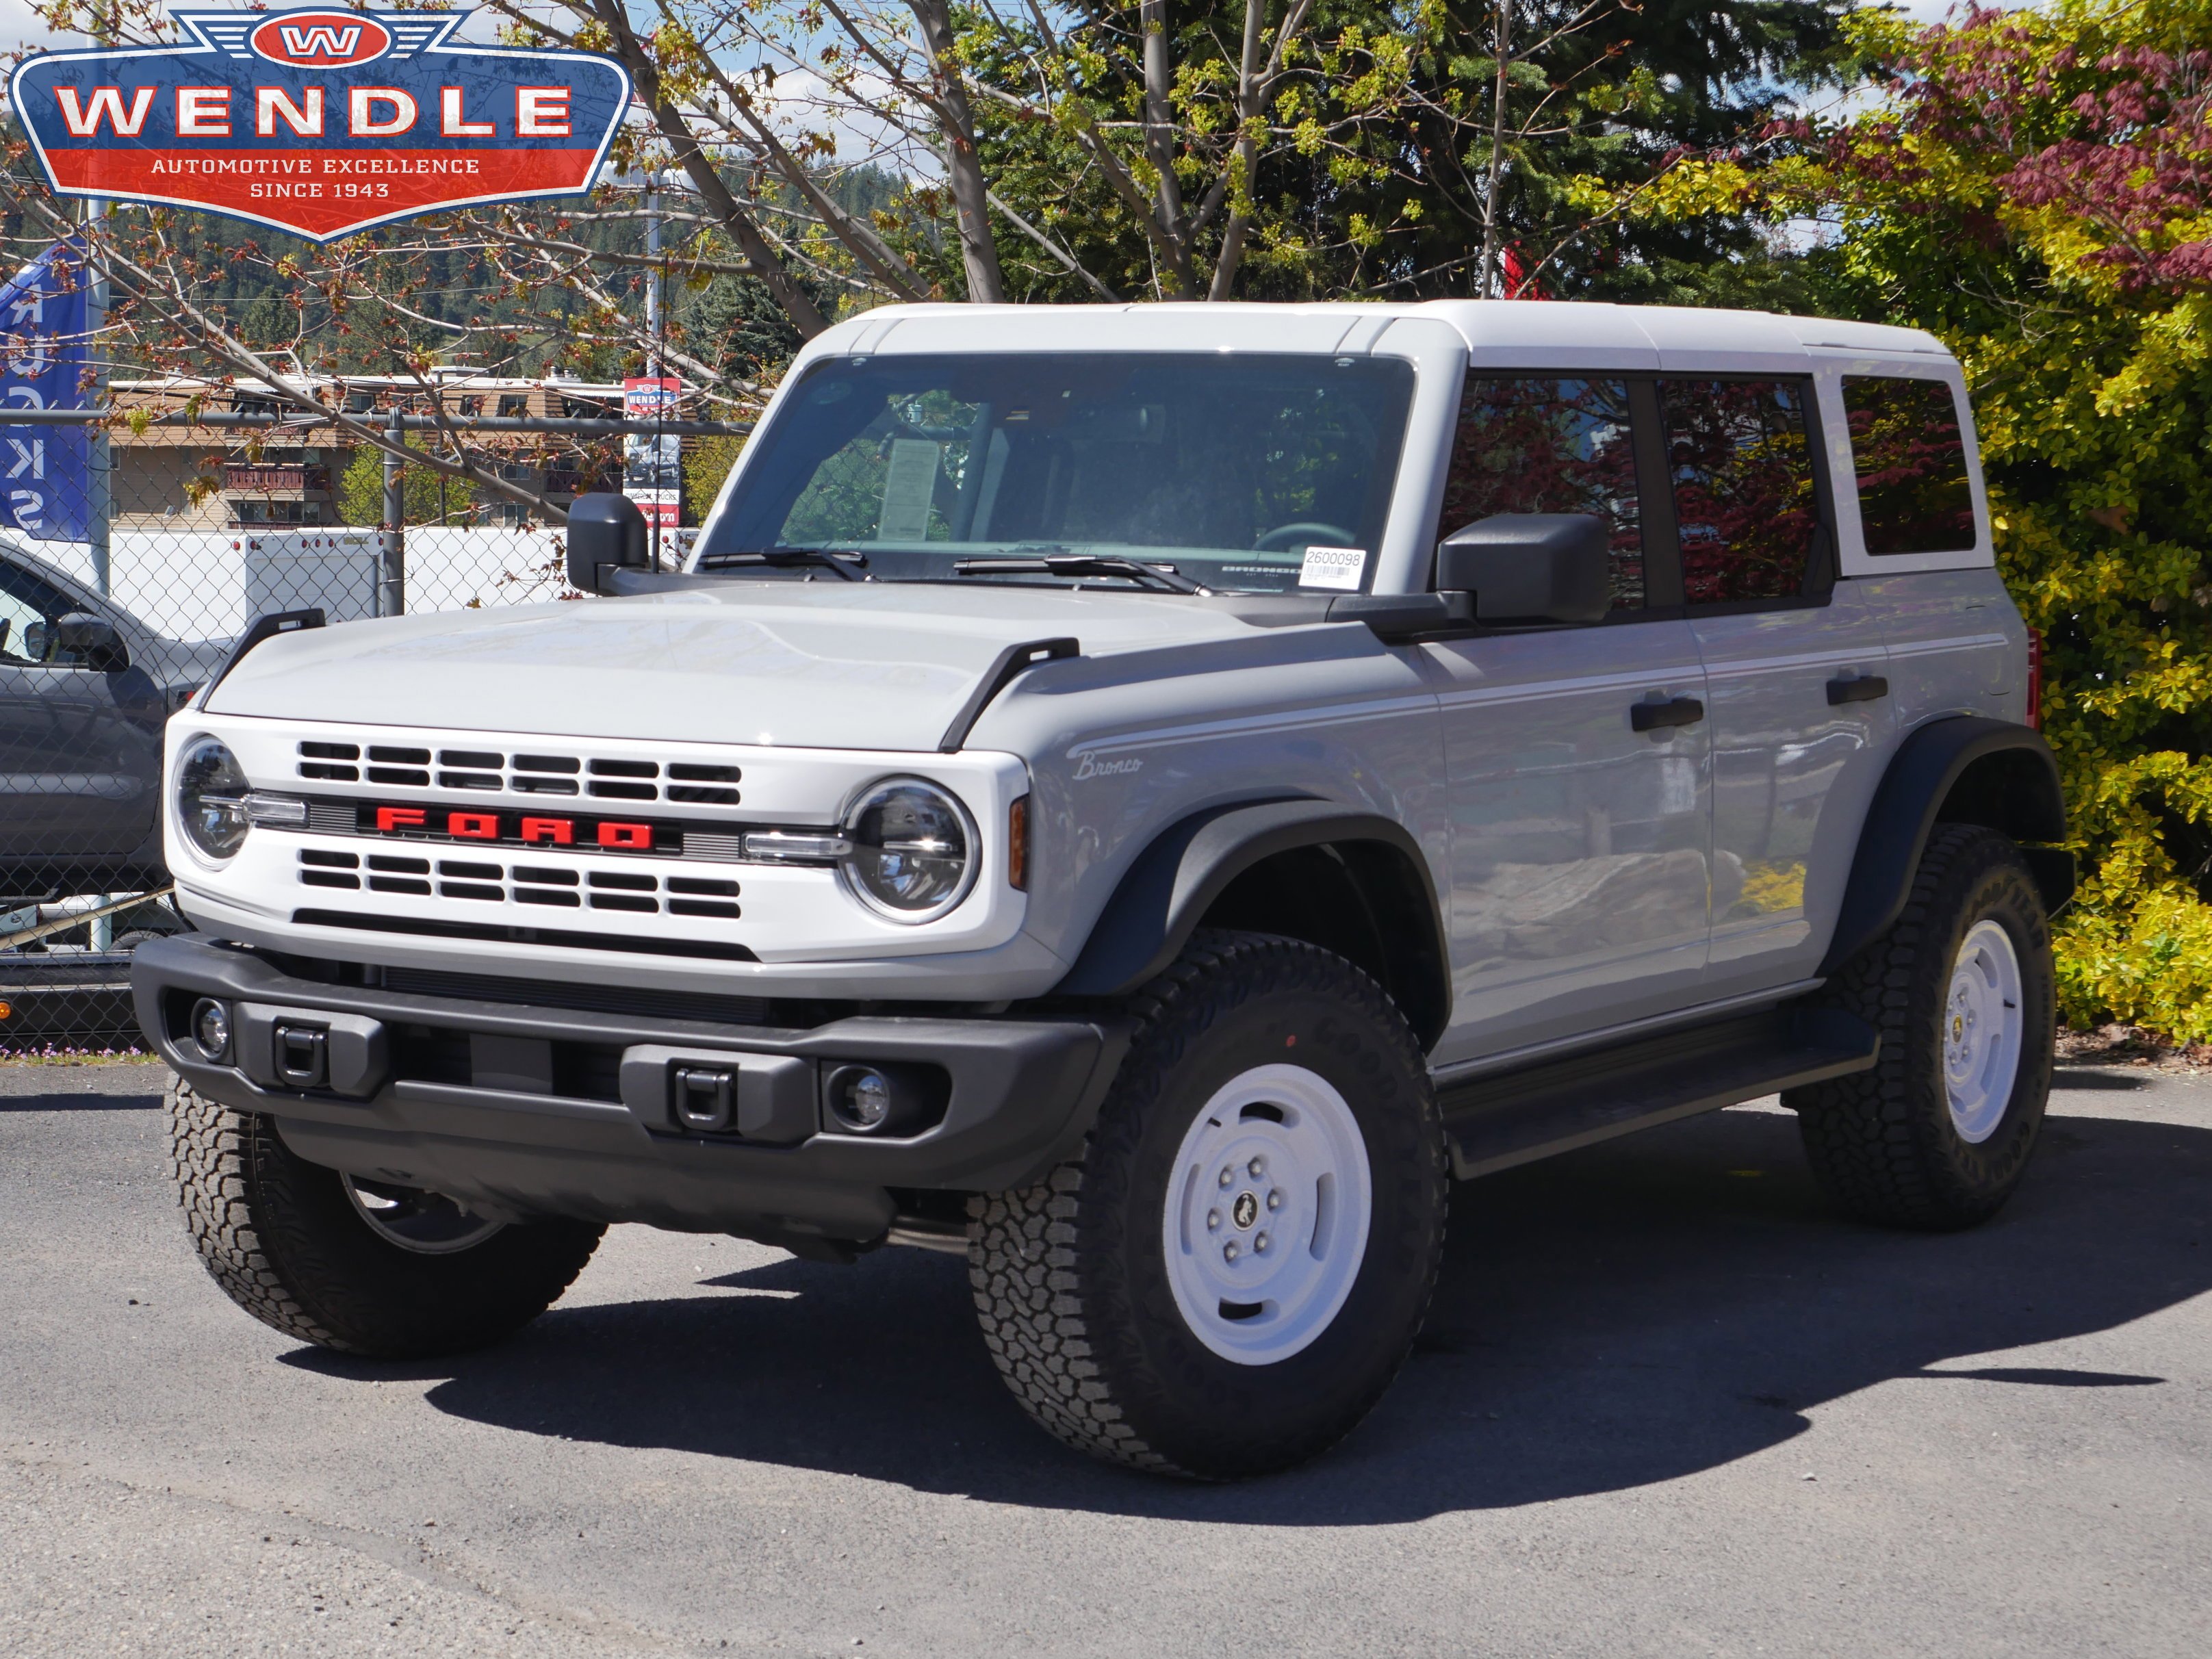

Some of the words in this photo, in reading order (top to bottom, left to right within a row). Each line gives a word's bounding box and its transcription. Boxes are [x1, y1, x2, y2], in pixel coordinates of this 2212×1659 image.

[1307, 551, 1360, 566] 2600098
[1072, 750, 1144, 780] Bronco
[377, 807, 653, 849] FORD
